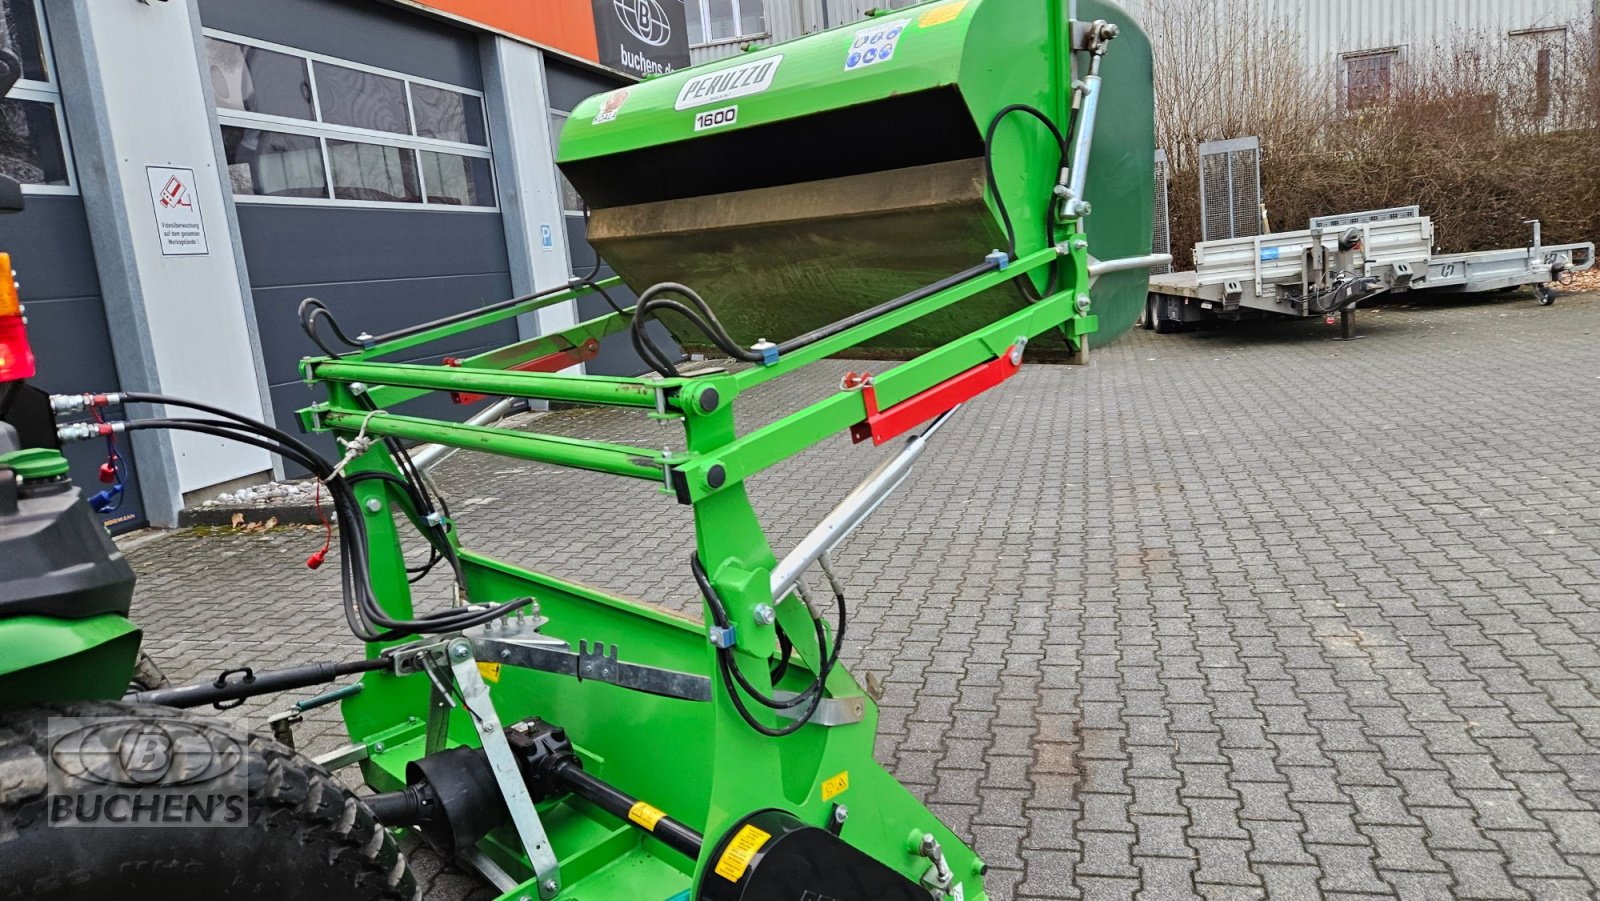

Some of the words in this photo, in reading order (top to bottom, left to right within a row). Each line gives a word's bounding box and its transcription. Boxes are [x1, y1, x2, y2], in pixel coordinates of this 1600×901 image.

[682, 61, 774, 101] PERUZZO
[697, 108, 736, 128] 1600
[542, 226, 550, 245] P
